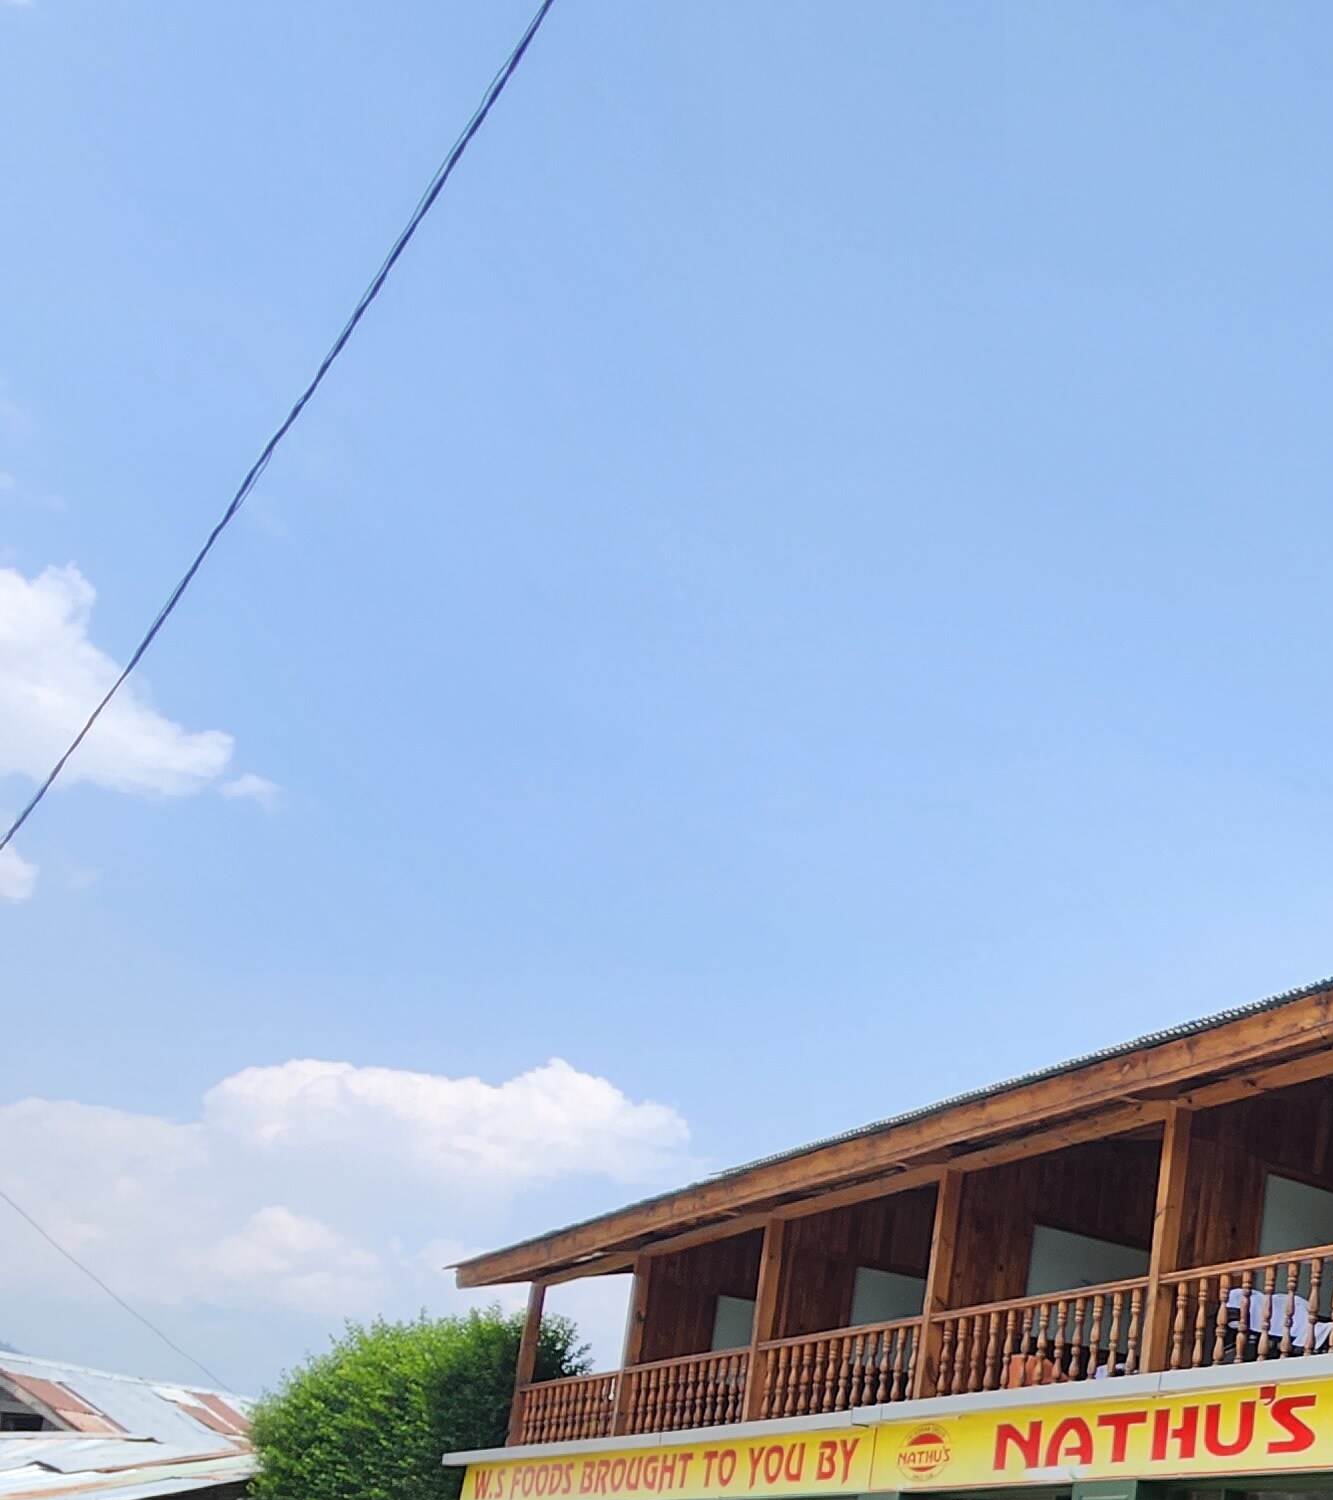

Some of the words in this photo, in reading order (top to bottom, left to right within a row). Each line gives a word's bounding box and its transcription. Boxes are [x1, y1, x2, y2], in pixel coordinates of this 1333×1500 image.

[897, 1446, 951, 1466] NATHU'S
[994, 1383, 1317, 1472] NATHU'S
[579, 1452, 694, 1496] BROUGHT
[703, 1449, 737, 1487] TO
[748, 1444, 803, 1489] YOU
[815, 1438, 861, 1483] BY
